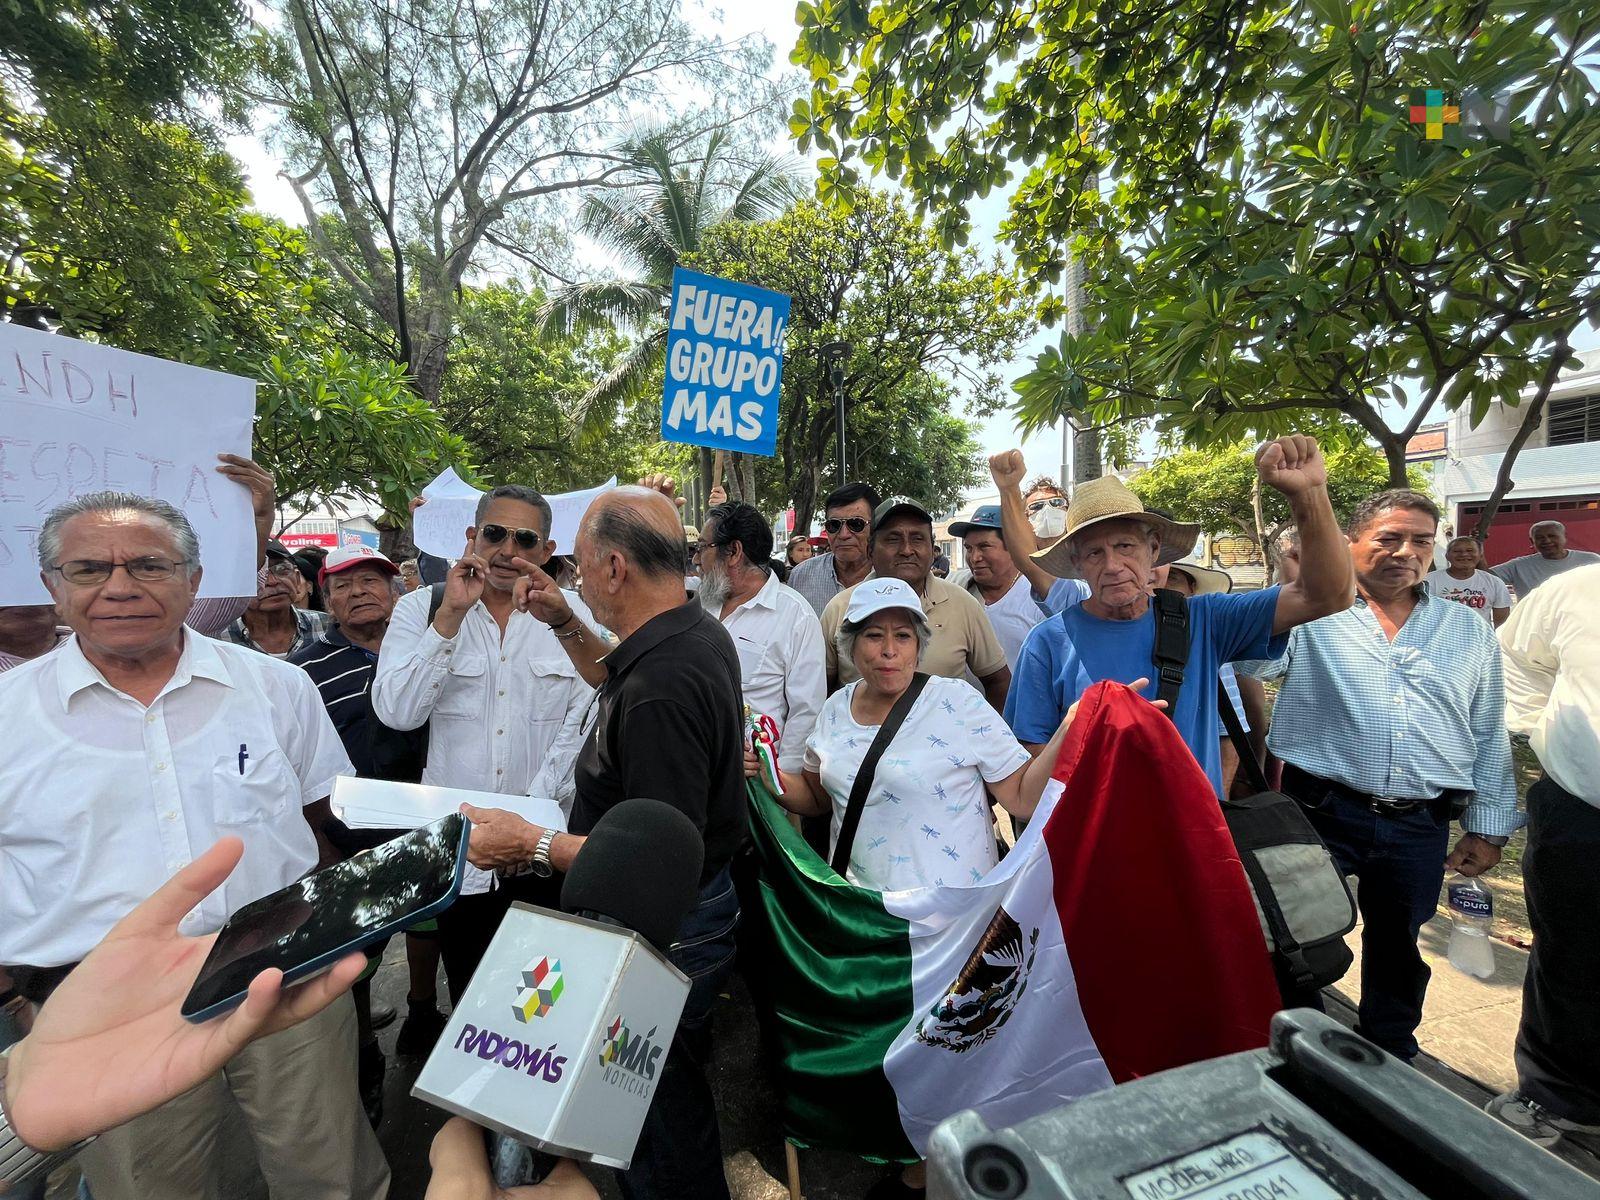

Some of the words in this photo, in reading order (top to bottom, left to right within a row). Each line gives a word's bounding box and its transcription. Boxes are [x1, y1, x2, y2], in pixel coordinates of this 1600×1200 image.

[672, 284, 786, 356] FUERA!!
[670, 338, 778, 397] GRUPO
[667, 388, 764, 442] MAS
[454, 1023, 568, 1084] RADIOMÁS
[618, 1024, 663, 1081] MÁS
[602, 1066, 651, 1100] NOTICIAS
